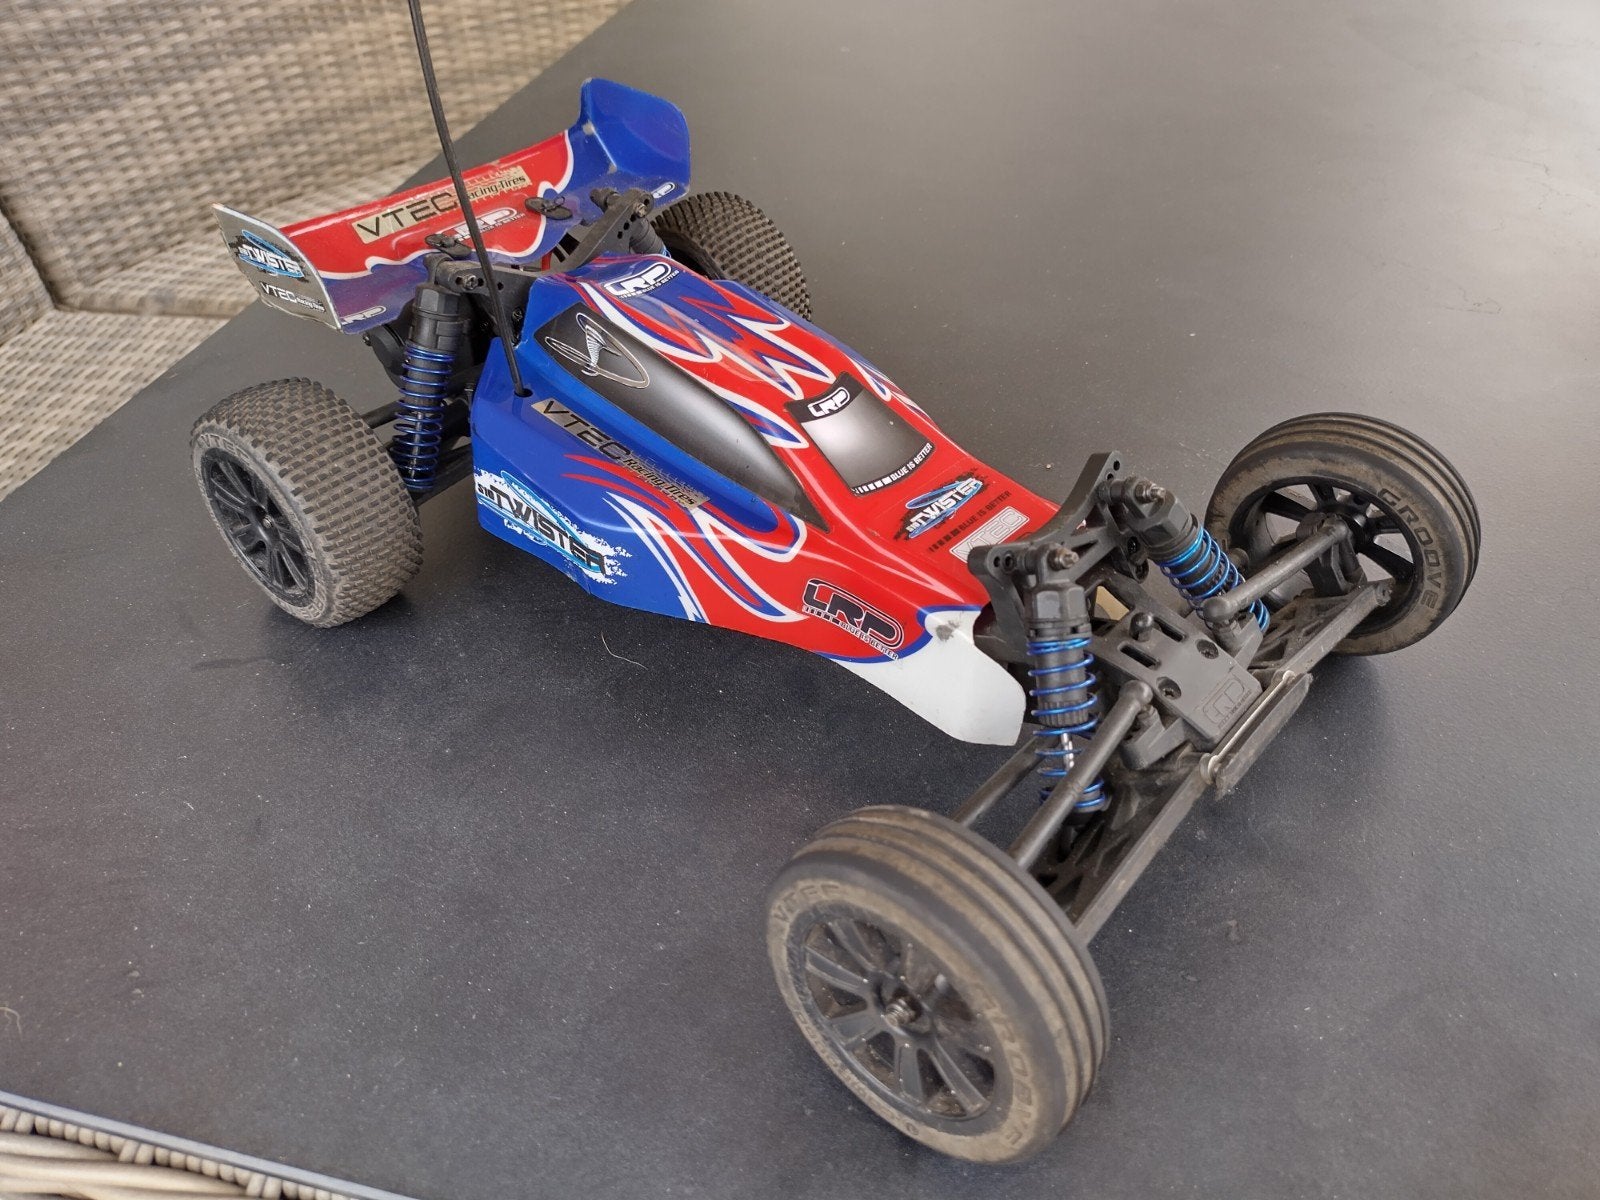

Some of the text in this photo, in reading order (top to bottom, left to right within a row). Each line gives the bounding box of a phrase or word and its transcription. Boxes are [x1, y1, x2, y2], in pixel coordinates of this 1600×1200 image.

[356, 192, 458, 237] VTEC
[260, 281, 298, 304] VTEC
[604, 262, 672, 296] LRP
[807, 386, 850, 418] LRP
[543, 400, 631, 460] VTEC
[890, 443, 933, 482] BLUE IS BETTER
[910, 477, 984, 529] TWISTER
[960, 491, 1012, 531] BLUE IS BETTER
[490, 484, 607, 576] TWISTER
[1377, 487, 1442, 610] GROOVE
[802, 578, 905, 650] LRP
